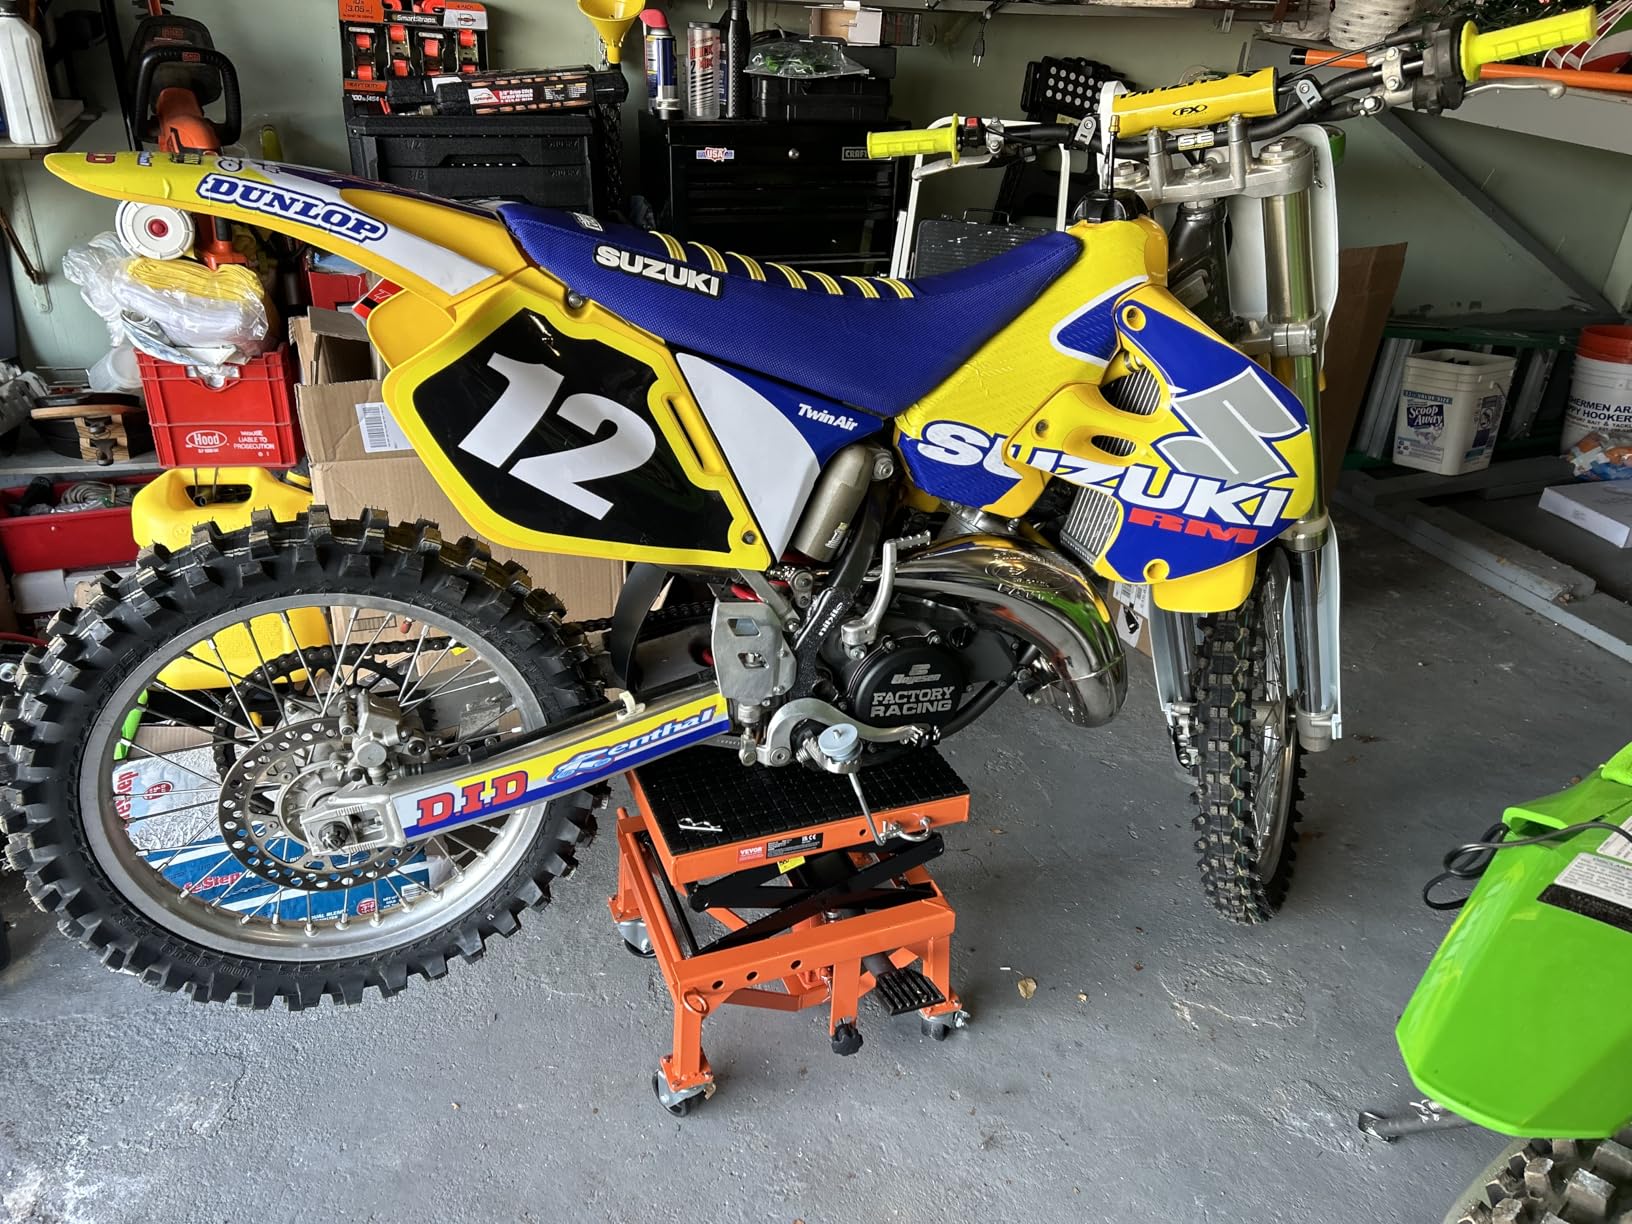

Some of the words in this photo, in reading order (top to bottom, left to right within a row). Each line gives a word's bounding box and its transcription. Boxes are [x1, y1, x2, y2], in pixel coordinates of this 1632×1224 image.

[705, 149, 724, 159] USA
[206, 177, 381, 236] DUNLOP
[595, 245, 720, 297] SUZUKI
[1408, 405, 1439, 419] Scoop
[1613, 405, 1632, 414] AR
[1414, 414, 1443, 426] Away
[193, 432, 220, 446] Hood
[457, 351, 657, 521] 12
[916, 423, 1292, 527] SUZUKI
[1127, 507, 1259, 545] RM
[871, 686, 956, 705] FACTORY
[870, 699, 953, 718] RACING
[739, 846, 763, 856] VEVOR
